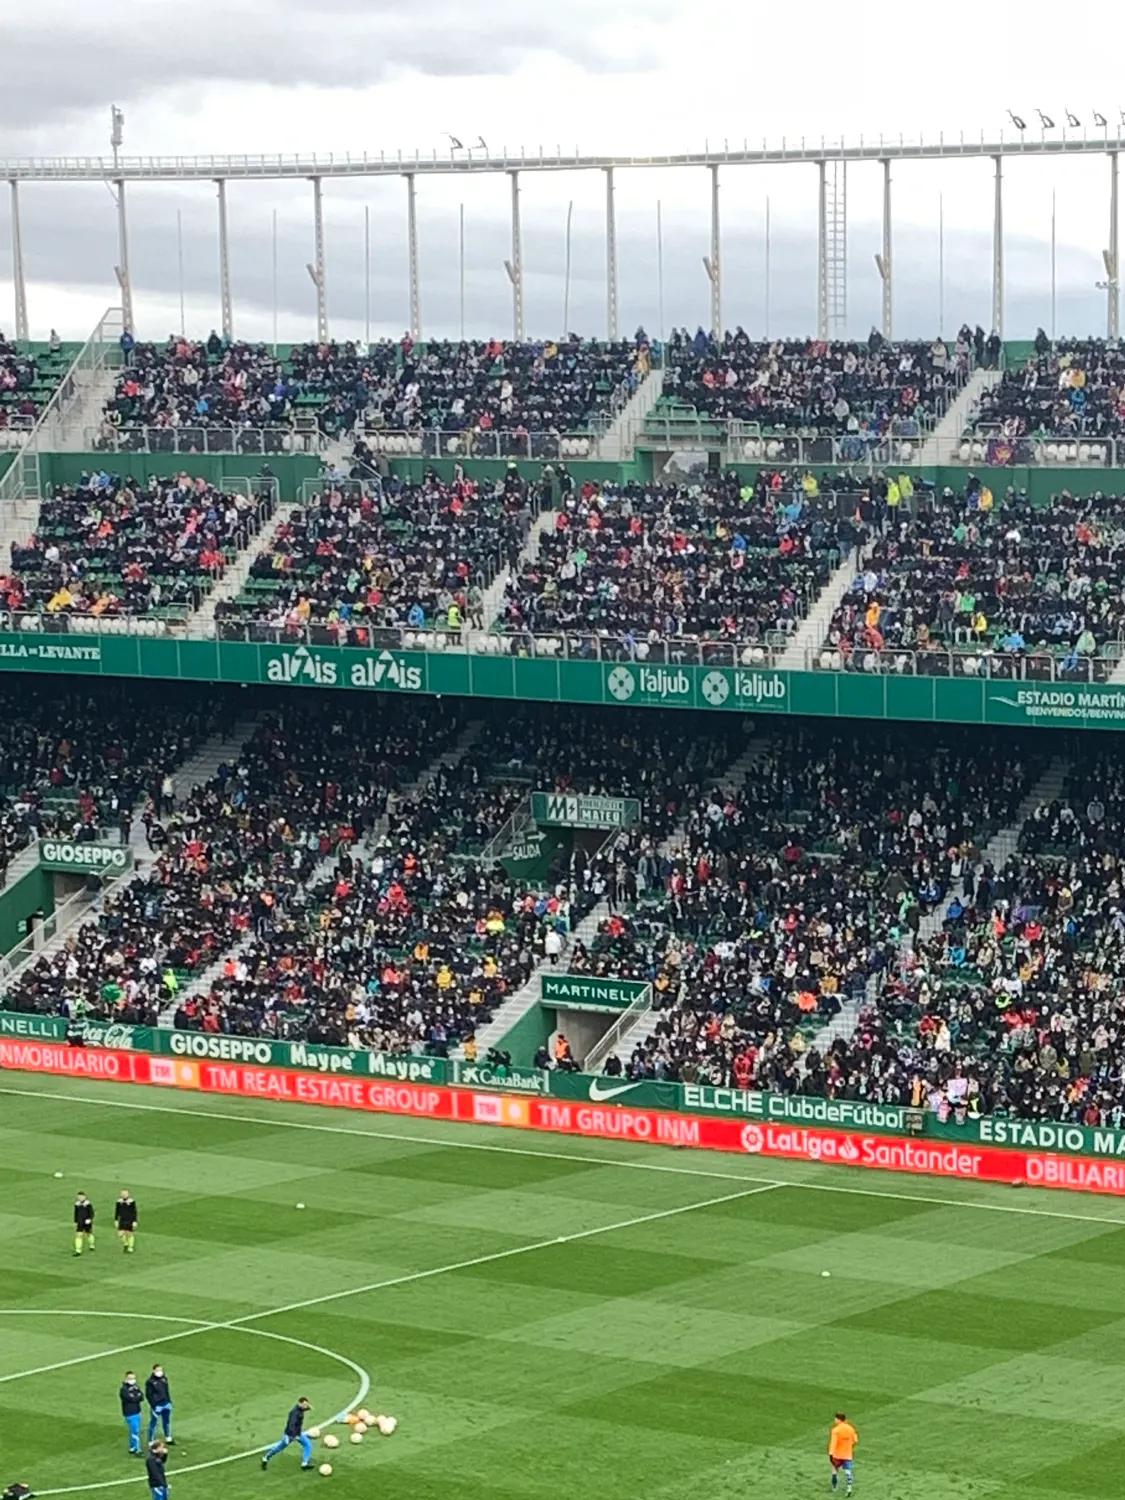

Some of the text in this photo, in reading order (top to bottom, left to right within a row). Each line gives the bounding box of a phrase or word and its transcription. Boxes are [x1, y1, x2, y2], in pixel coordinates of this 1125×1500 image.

[39, 645, 101, 660] LEVANTE
[640, 668, 690, 698] l'aljub
[735, 672, 786, 703] l'aljub
[1017, 690, 1075, 706] ESTADIO
[43, 843, 126, 867] GIOSEPPO
[513, 843, 542, 861] SALIDA
[1, 1018, 58, 1038] NELLI
[0, 1044, 119, 1075] NMOBILIARIO
[170, 1033, 272, 1064] GIOSEPPO
[207, 1067, 441, 1112] TM REAL ESTATE GROUP
[684, 1086, 764, 1114] ELCHE
[537, 1104, 700, 1143] TM GRUPO INM
[979, 1119, 1084, 1151] ESTADIO
[768, 1130, 982, 1175] LaLiga Santander
